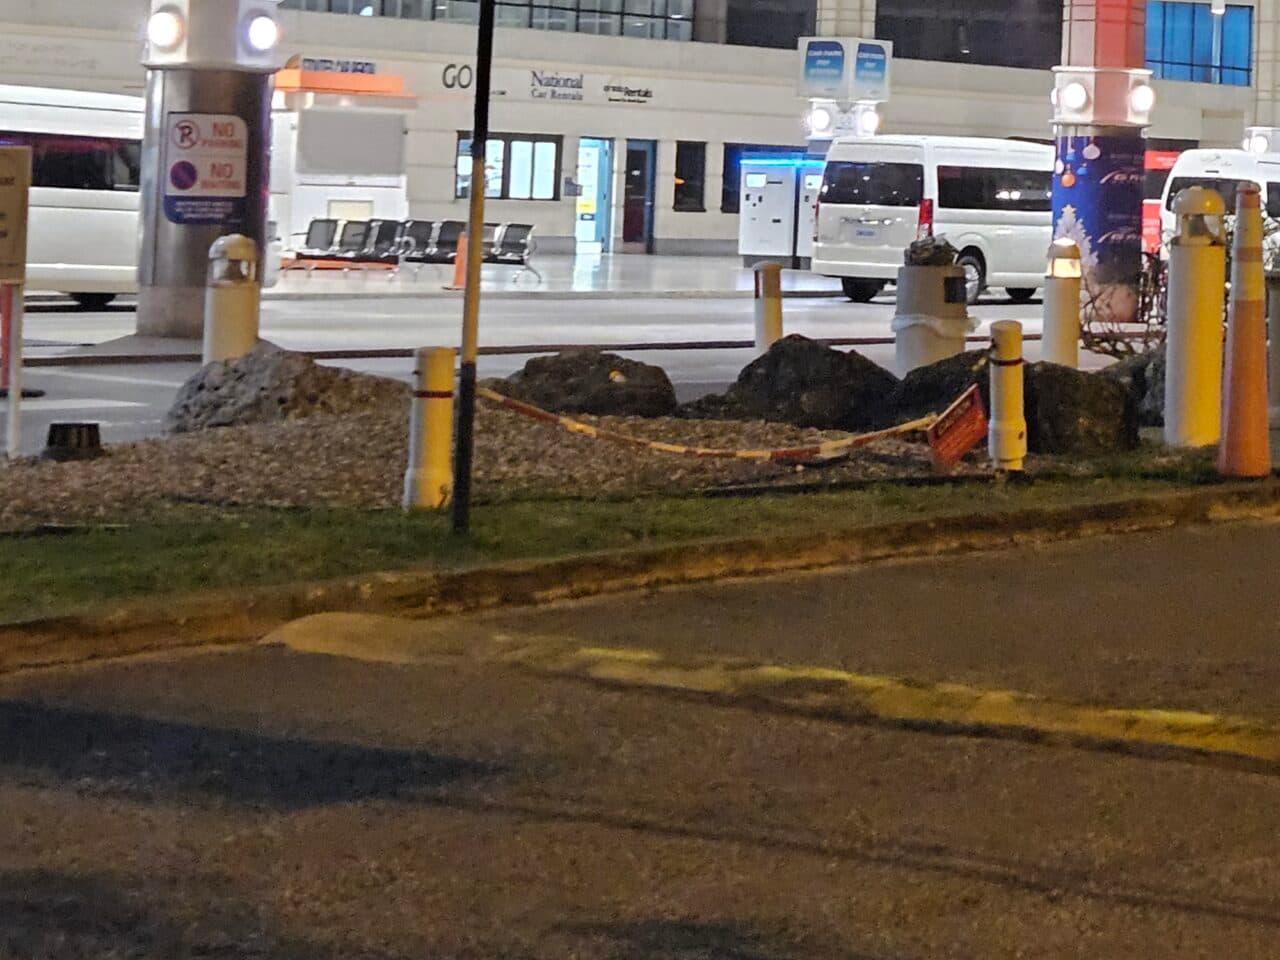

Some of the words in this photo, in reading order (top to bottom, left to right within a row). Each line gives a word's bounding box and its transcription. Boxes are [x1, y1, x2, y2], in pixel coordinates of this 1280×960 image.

[530, 70, 583, 89] National
[530, 88, 547, 99] Car
[550, 89, 583, 101] Rentals
[213, 122, 235, 137] NO
[210, 162, 233, 179] NO
